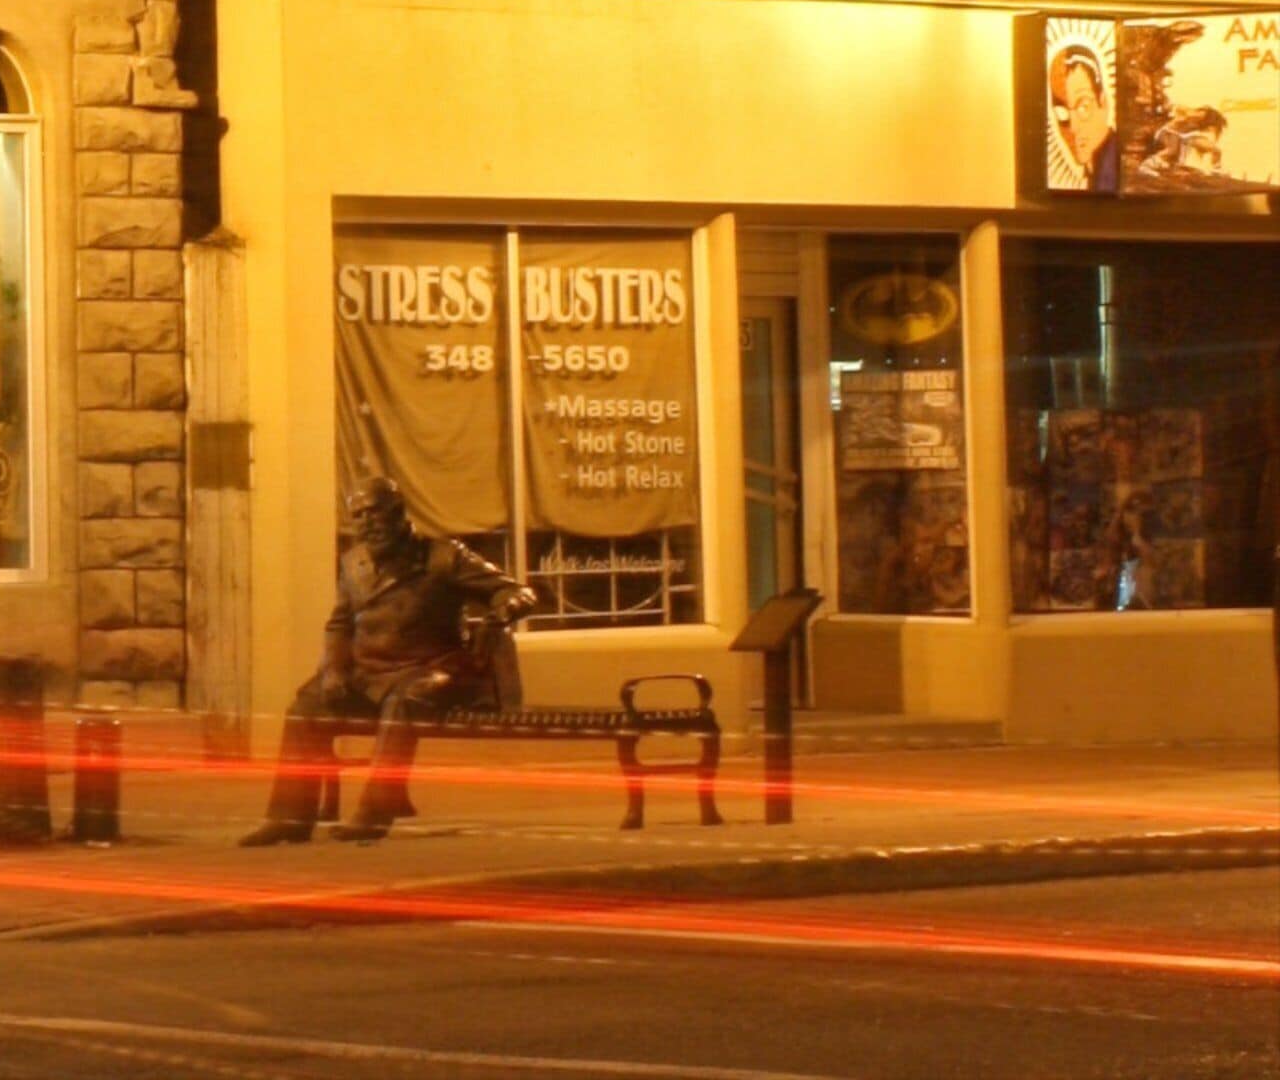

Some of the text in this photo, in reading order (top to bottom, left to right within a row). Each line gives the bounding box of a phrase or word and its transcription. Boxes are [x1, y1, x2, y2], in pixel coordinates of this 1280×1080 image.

[338, 264, 687, 324] STRESS BUSTERS
[424, 344, 495, 372] 348
[576, 429, 617, 454] Hot
[624, 430, 686, 454] Stone
[576, 464, 618, 489] Hot
[625, 464, 684, 489] Relax
